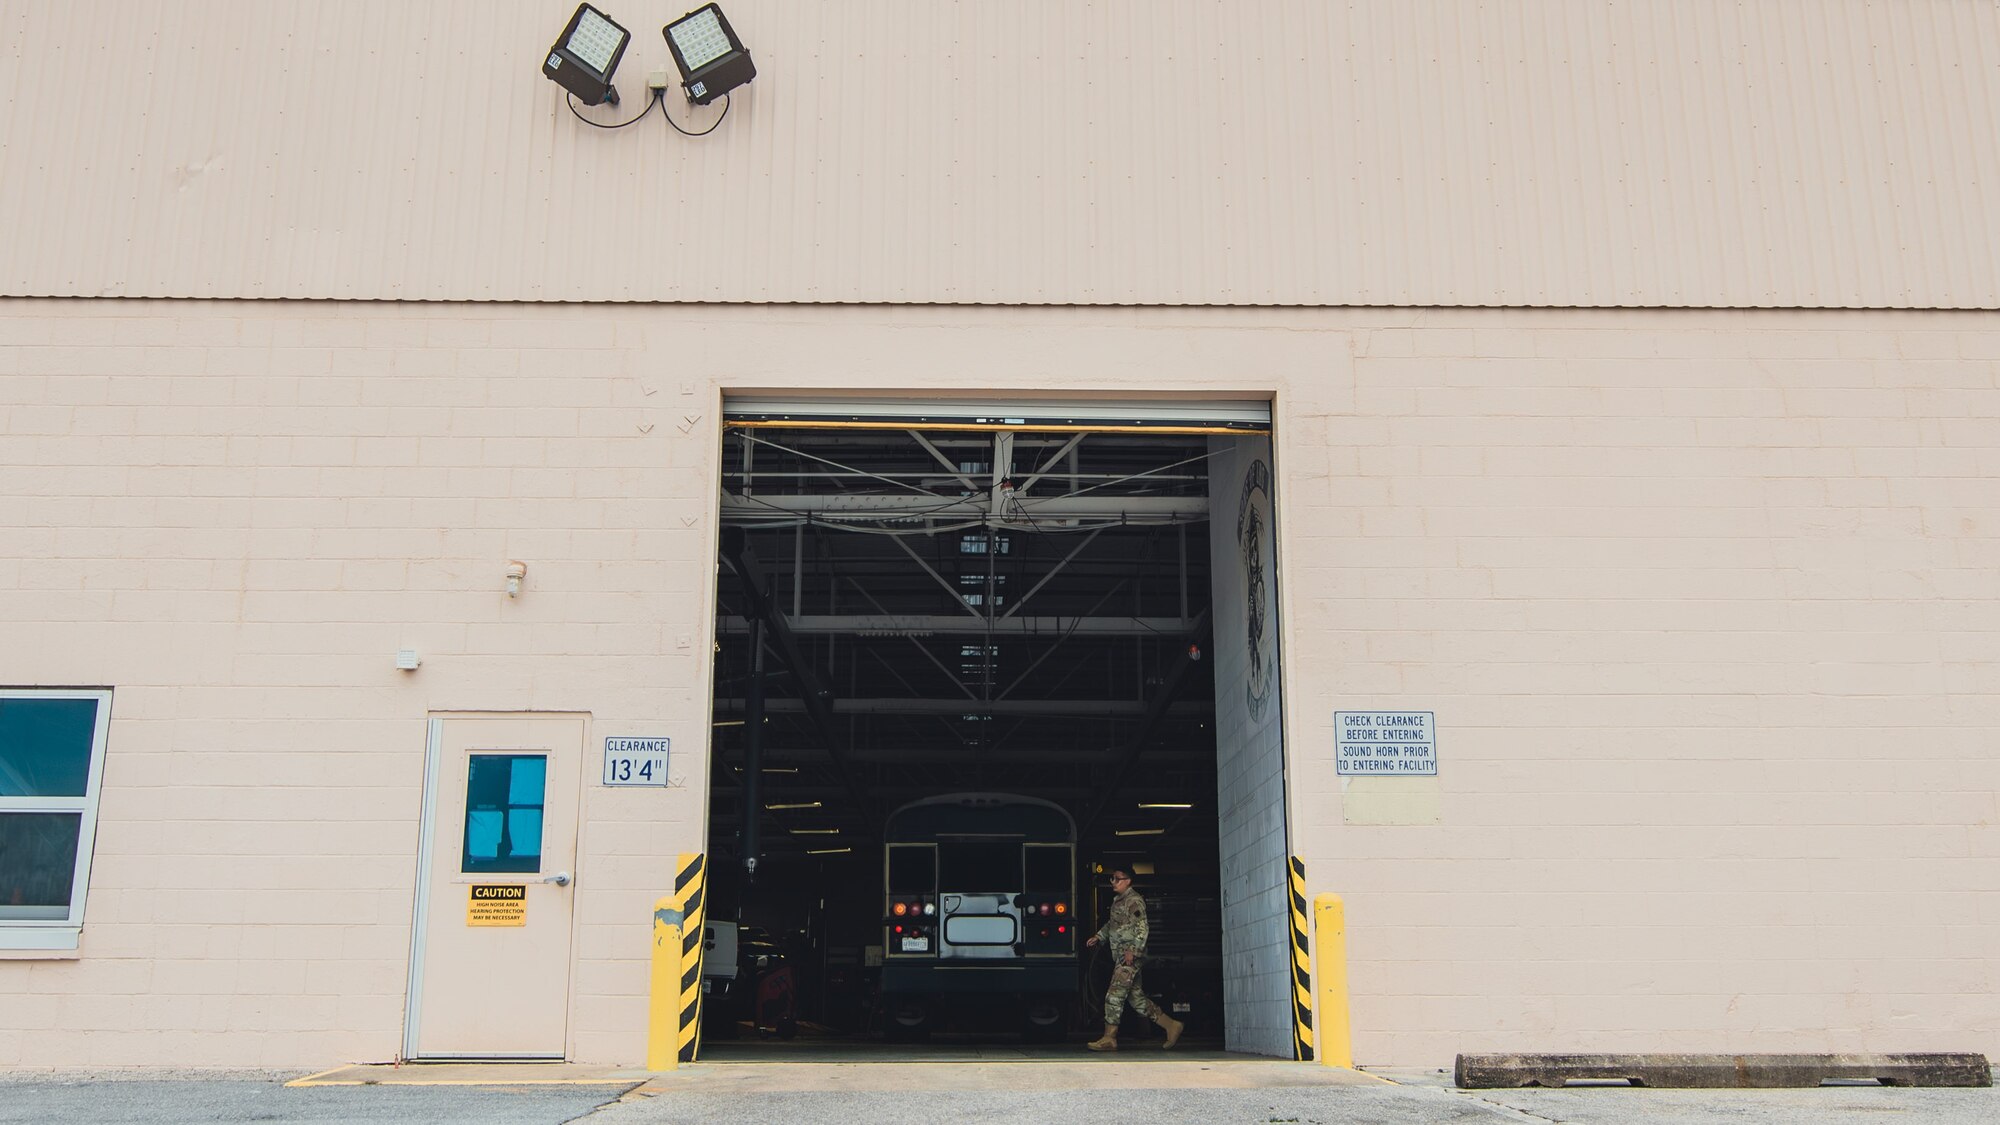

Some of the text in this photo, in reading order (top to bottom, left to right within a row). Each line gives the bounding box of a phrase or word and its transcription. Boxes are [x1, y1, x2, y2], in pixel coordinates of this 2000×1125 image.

[1344, 716, 1424, 726] CHECK CLEARANCE
[1346, 730, 1424, 740] BEFORE ENTERING
[608, 741, 666, 751] CLEARANCE
[1343, 746, 1429, 757] SOUND HORN PRIOR
[611, 759, 662, 781] 13'4"
[1339, 760, 1435, 770] TO ENTERING FACILITY
[475, 888, 522, 897] CAUTION
